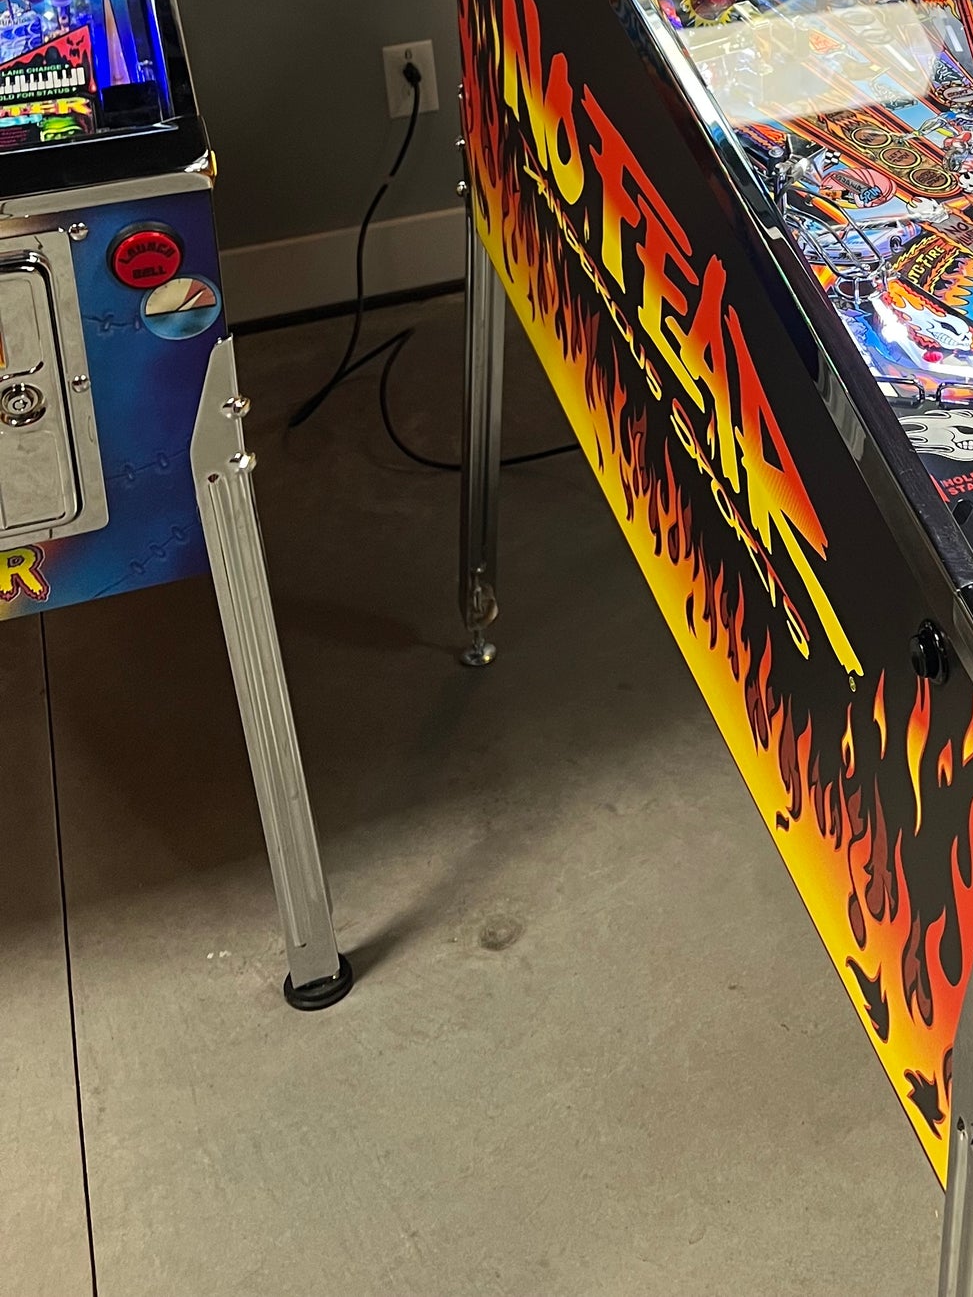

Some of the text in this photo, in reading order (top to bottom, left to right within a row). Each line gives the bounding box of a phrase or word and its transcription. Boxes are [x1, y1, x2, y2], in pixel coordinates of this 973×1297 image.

[2, 64, 62, 77] LANE CHANGE
[17, 88, 70, 99] FOR STATUS
[119, 242, 176, 264] LAUNCH
